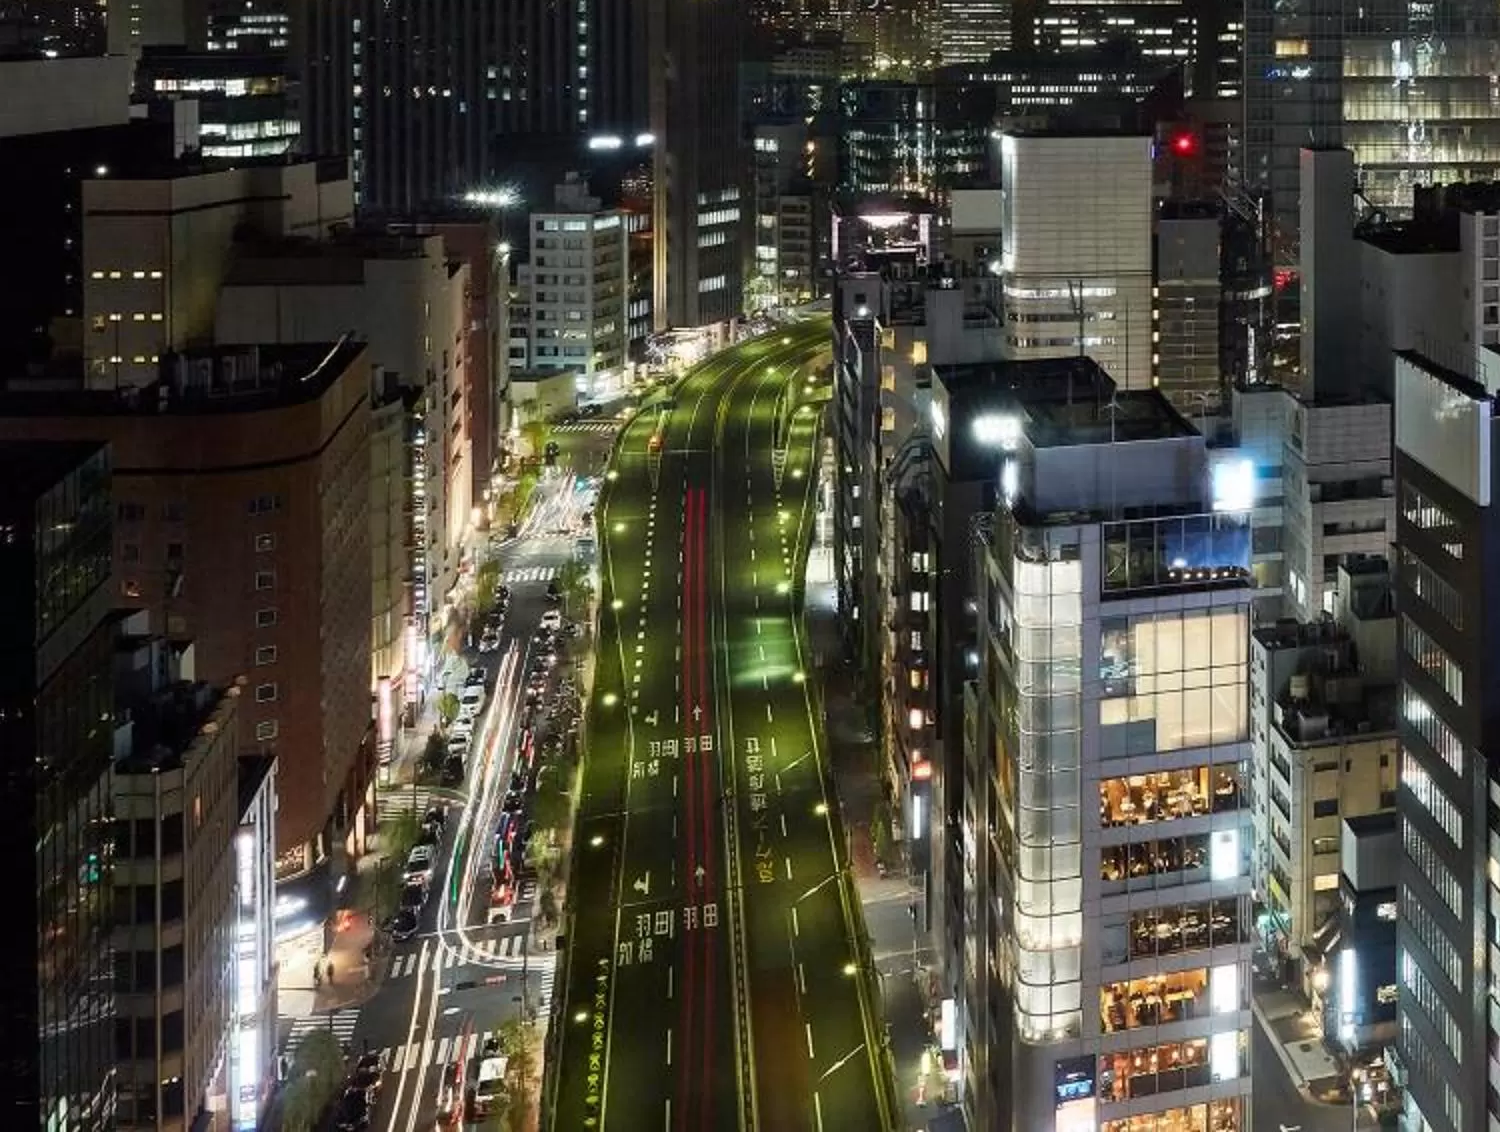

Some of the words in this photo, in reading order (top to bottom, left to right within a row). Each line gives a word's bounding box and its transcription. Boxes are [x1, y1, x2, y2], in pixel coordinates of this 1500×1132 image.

[684, 735, 713, 753] 羽田
[636, 911, 669, 938] 羽田
[683, 903, 719, 931] 羽田
